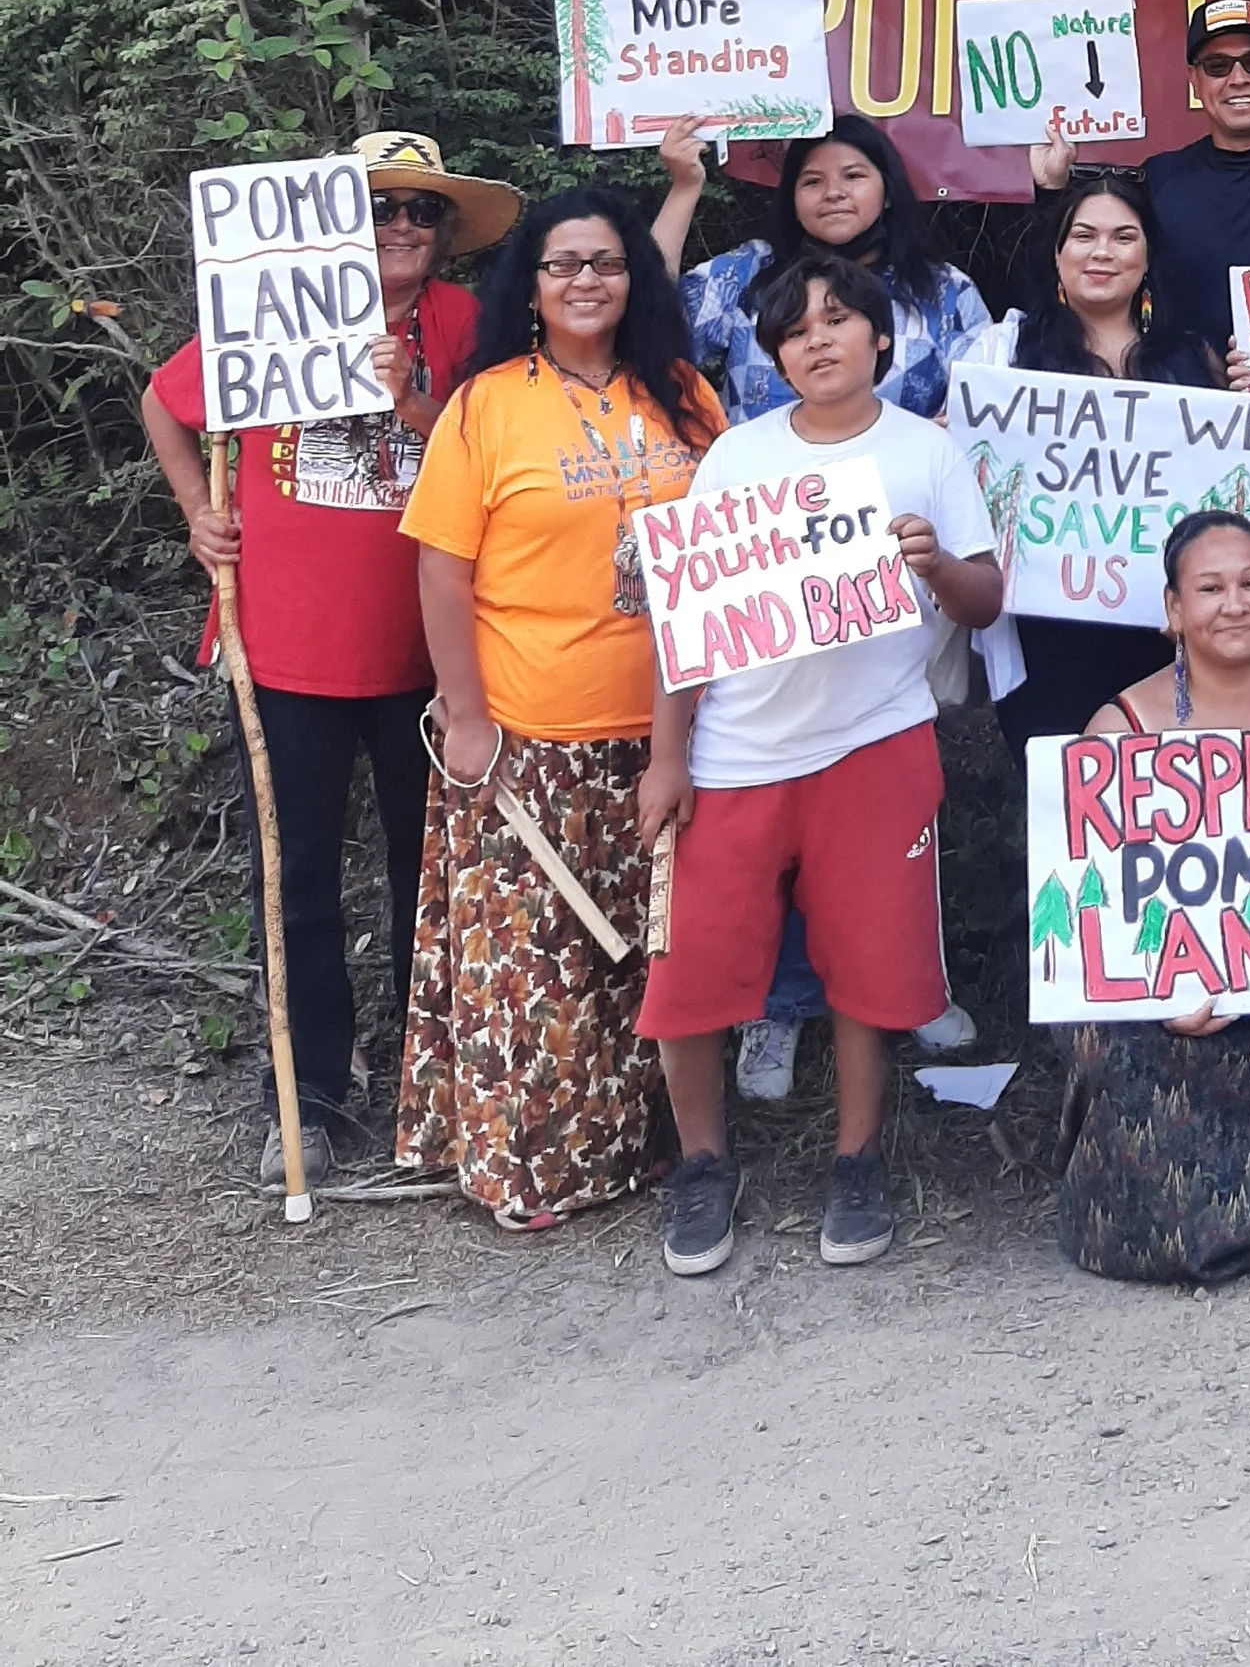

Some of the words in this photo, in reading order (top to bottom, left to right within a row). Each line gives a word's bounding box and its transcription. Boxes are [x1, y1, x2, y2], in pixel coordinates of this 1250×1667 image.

[1052, 10, 1132, 38] Nature
[617, 38, 789, 82] Standing
[966, 30, 1042, 114] NO
[198, 165, 367, 246] POMO
[210, 260, 379, 345] LAND
[217, 342, 384, 424] BACK
[960, 381, 1151, 436] WHAT
[1035, 442, 1172, 497] SAVE
[1061, 553, 1129, 609] US
[659, 593, 797, 684] LAND
[803, 552, 916, 645] BACK
